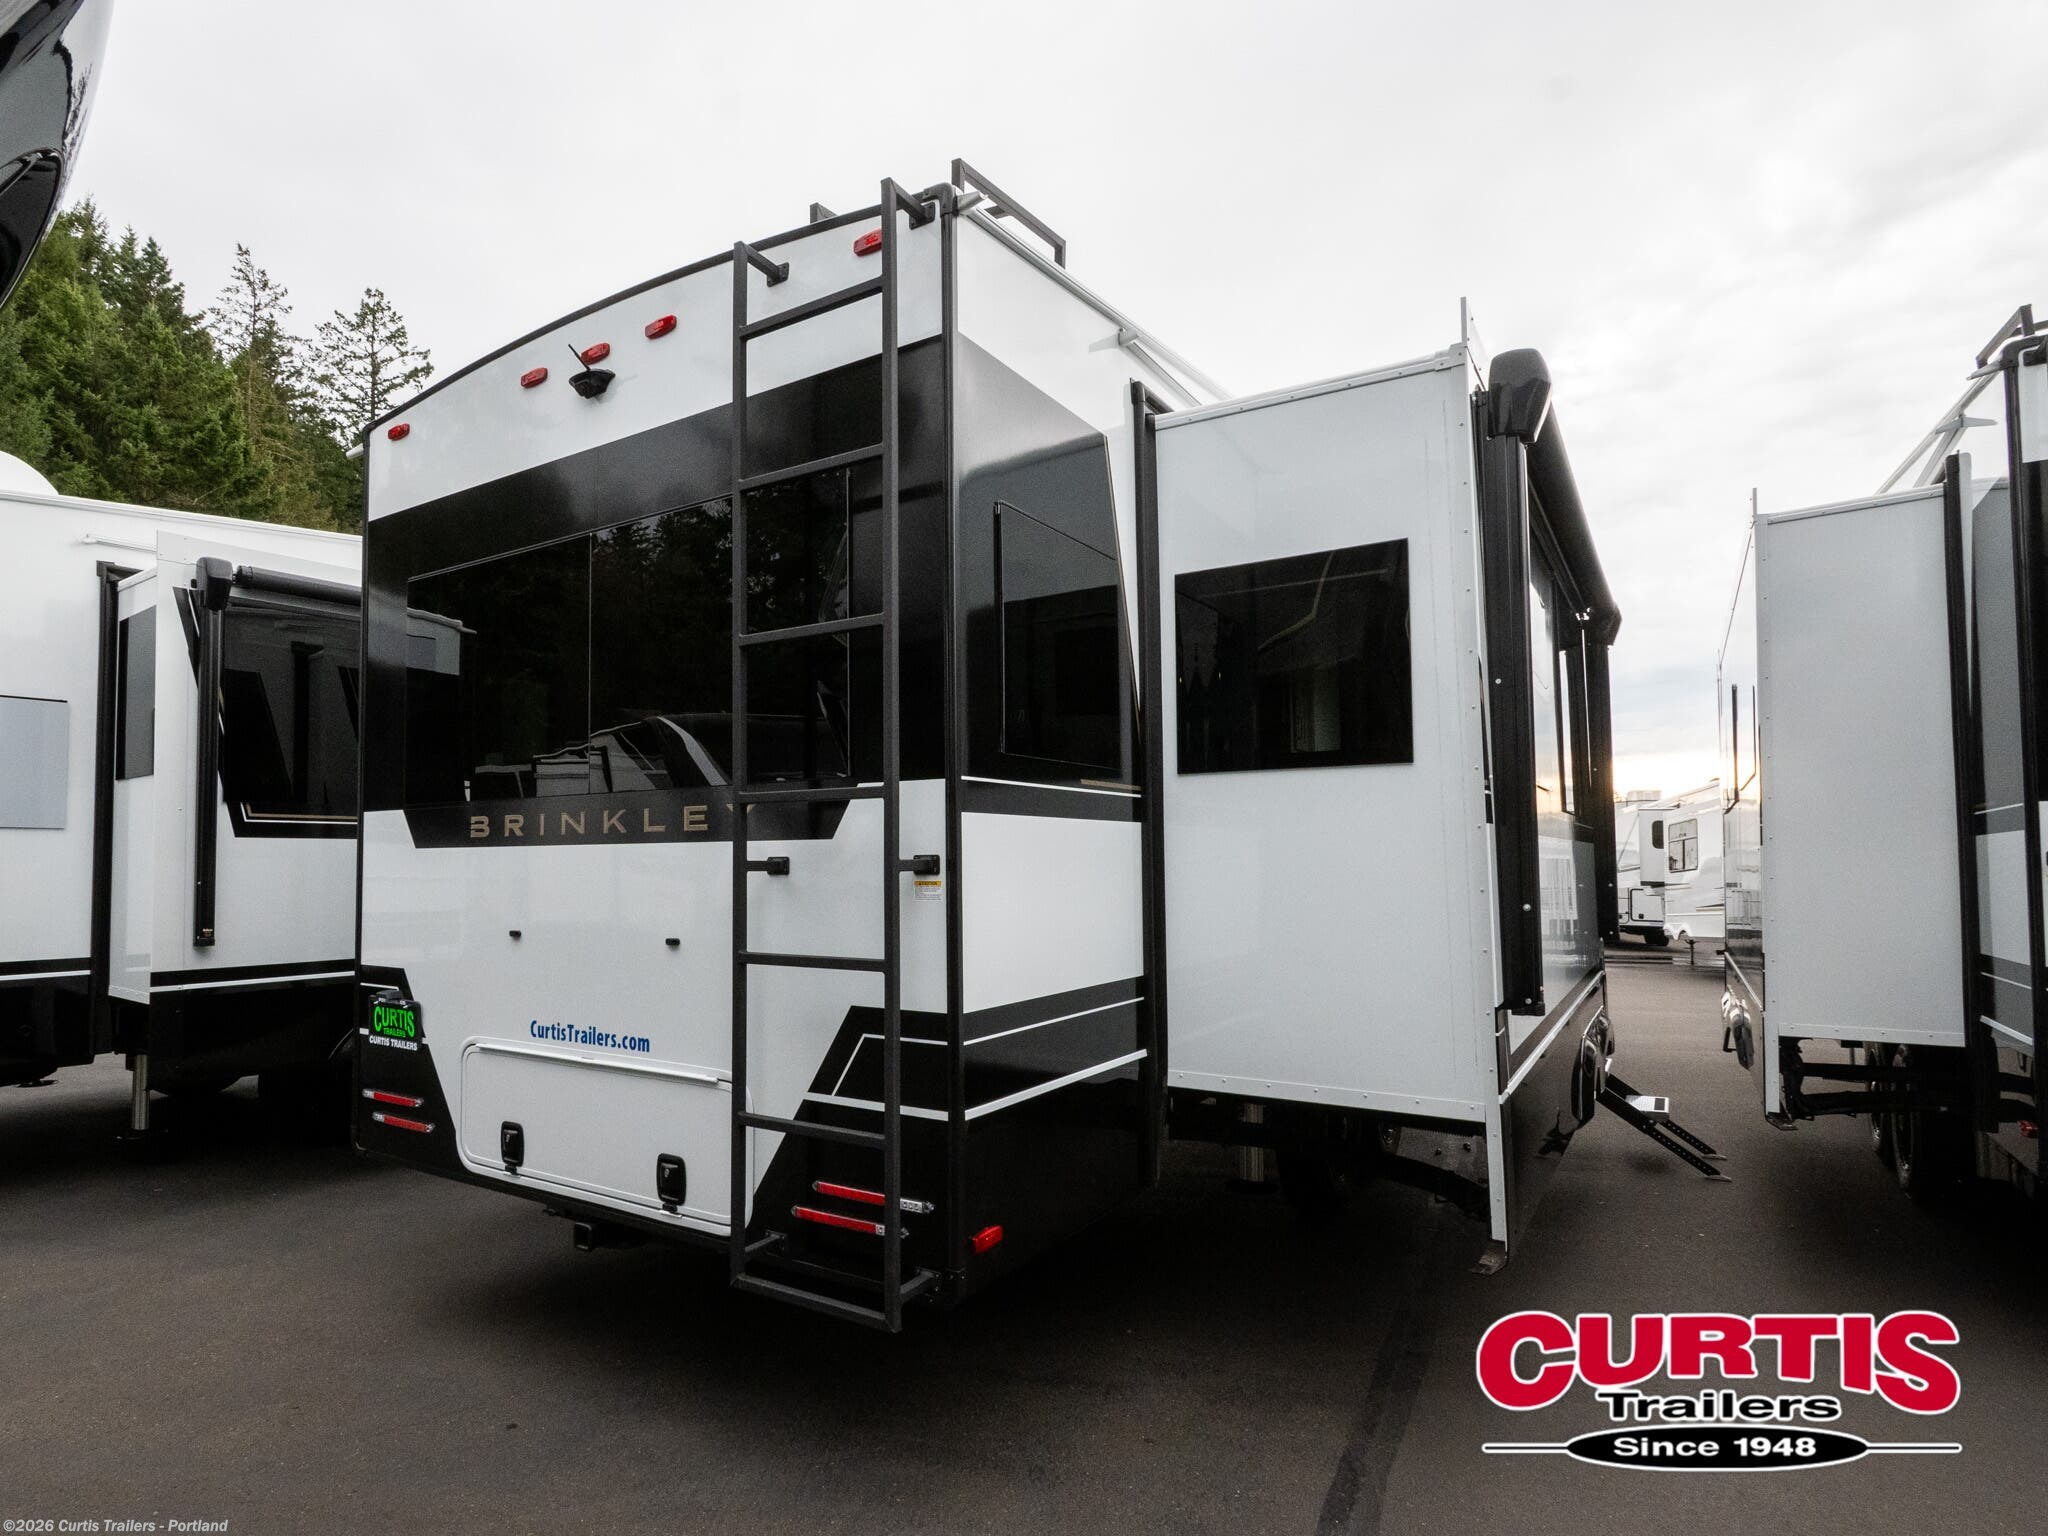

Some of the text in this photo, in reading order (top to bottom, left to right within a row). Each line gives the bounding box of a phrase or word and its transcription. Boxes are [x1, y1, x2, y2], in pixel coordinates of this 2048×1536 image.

[469, 804, 757, 838] BRINKLE
[374, 1006, 415, 1038] CURTIS
[530, 1020, 650, 1053] CurtisTrailers.com
[369, 1035, 418, 1051] CURTIS TRAILERS
